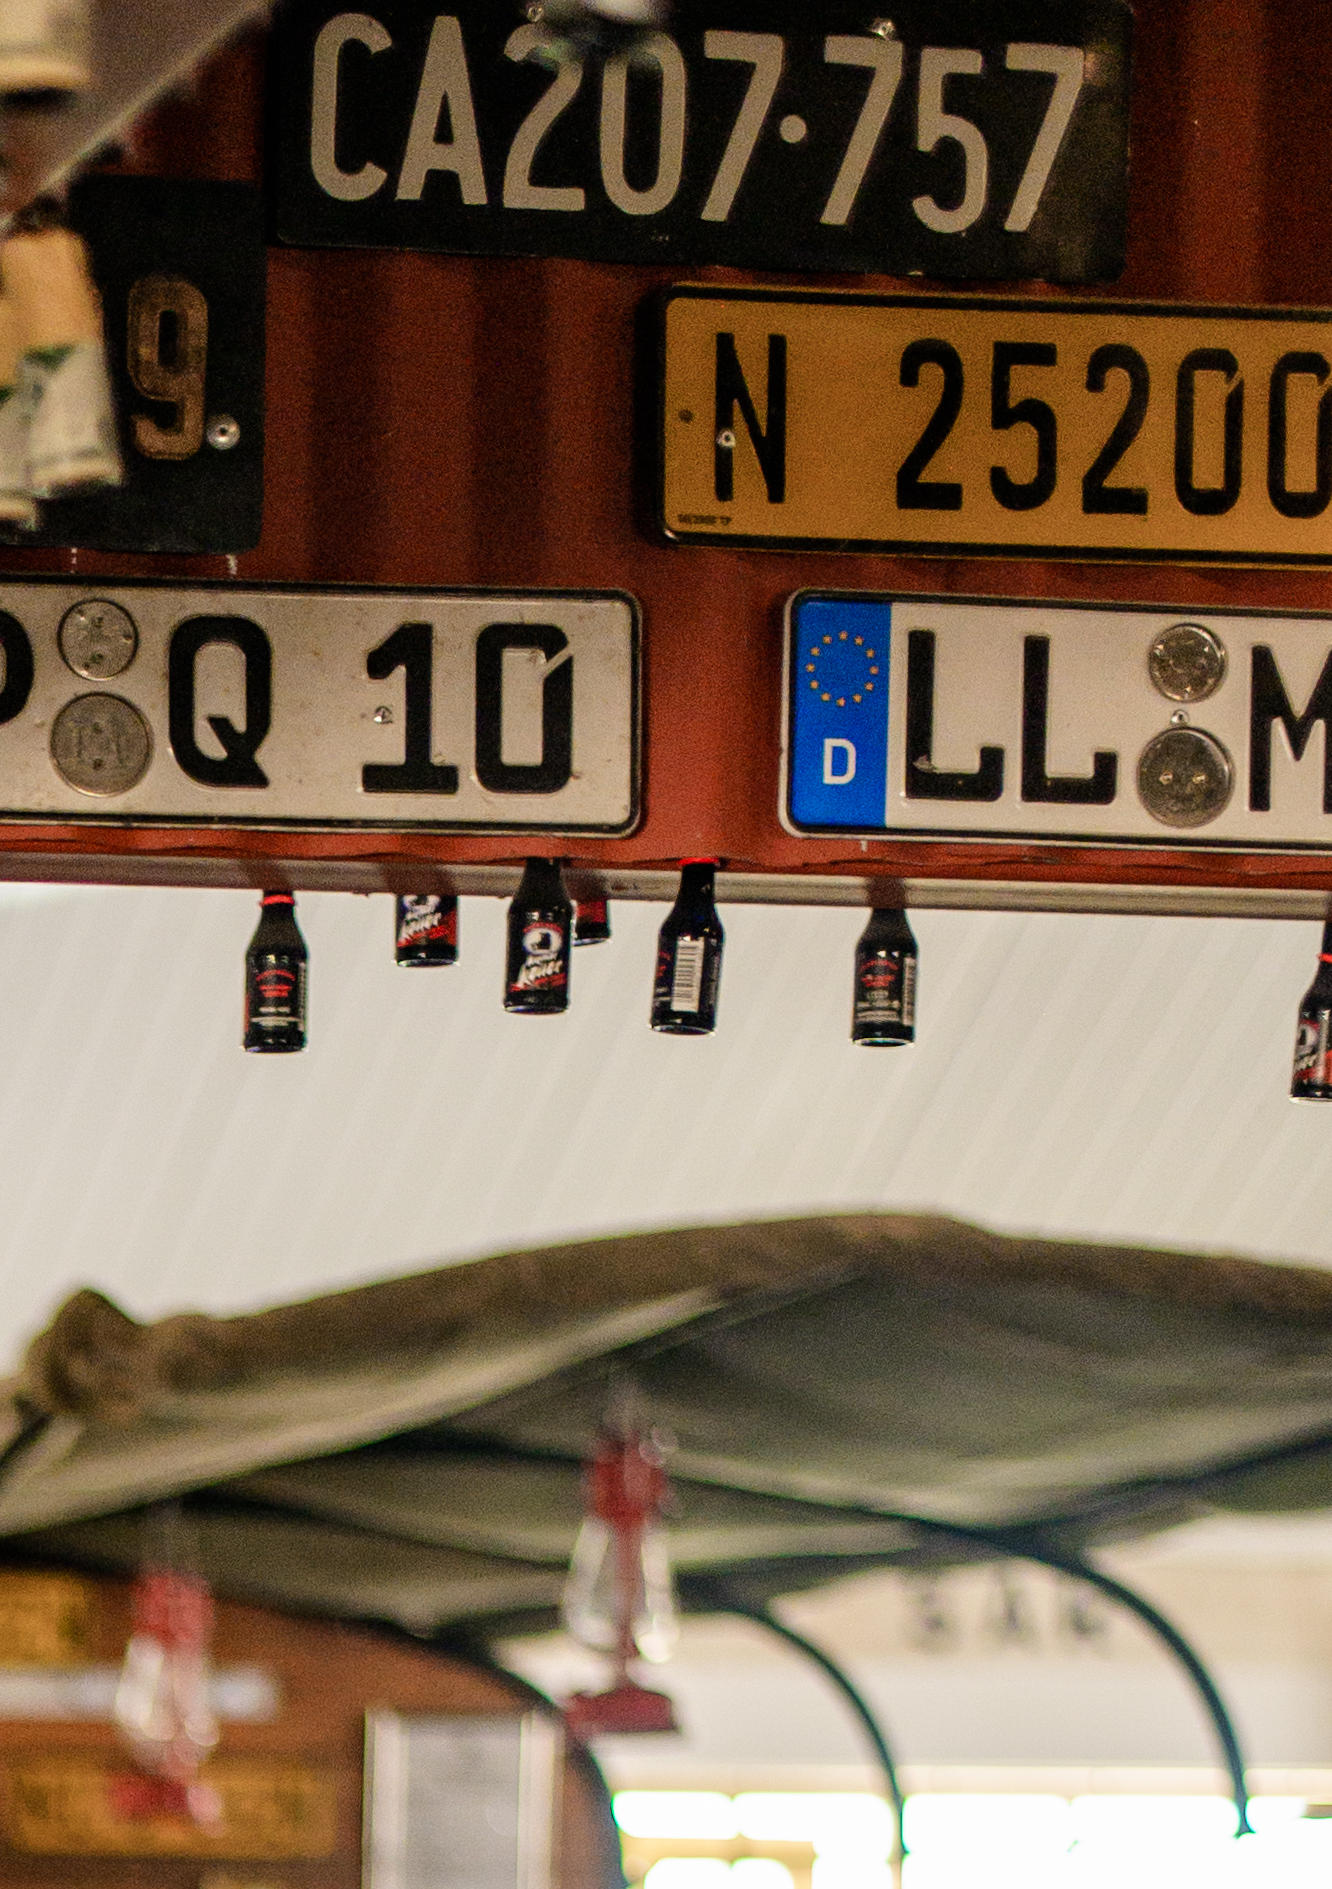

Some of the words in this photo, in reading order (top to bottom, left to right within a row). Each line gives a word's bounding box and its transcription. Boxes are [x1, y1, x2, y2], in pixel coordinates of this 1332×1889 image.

[714, 331, 787, 503] N
[896, 338, 1332, 519] 25200
[168, 613, 273, 789] Q
[362, 620, 576, 796] 10
[823, 738, 856, 785] D
[904, 629, 1118, 807] LL
